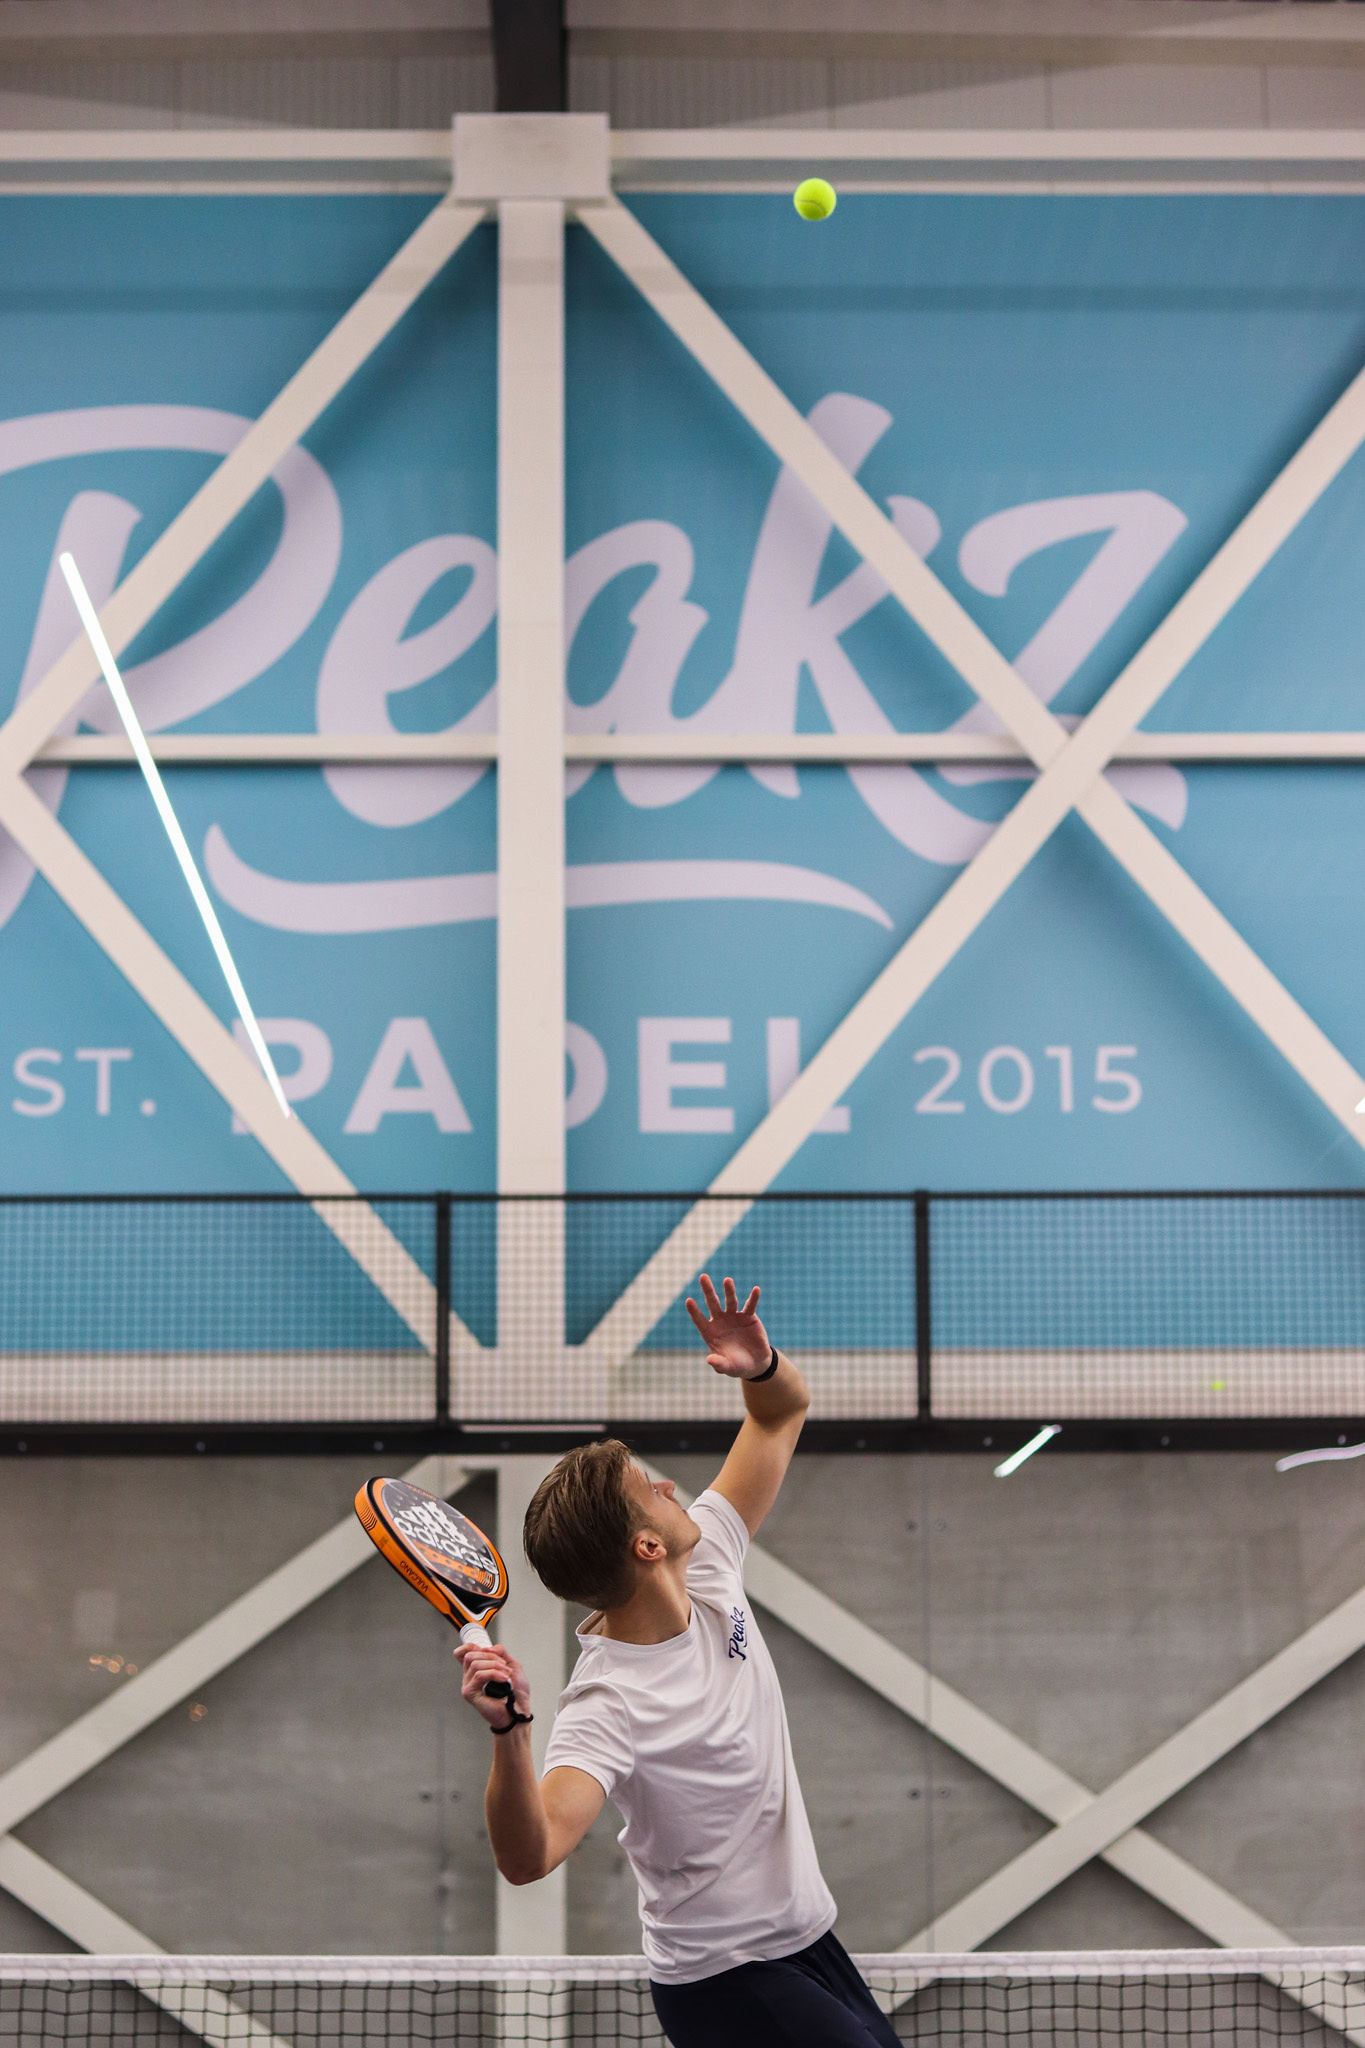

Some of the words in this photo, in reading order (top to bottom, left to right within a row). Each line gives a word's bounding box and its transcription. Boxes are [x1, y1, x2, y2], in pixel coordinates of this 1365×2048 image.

[0, 392, 1188, 928] Peakz
[912, 1046, 1142, 1114] 2015
[393, 1516, 498, 1575] adidas
[400, 1560, 429, 1592] VULCANO
[728, 1606, 746, 1661] Peakz
